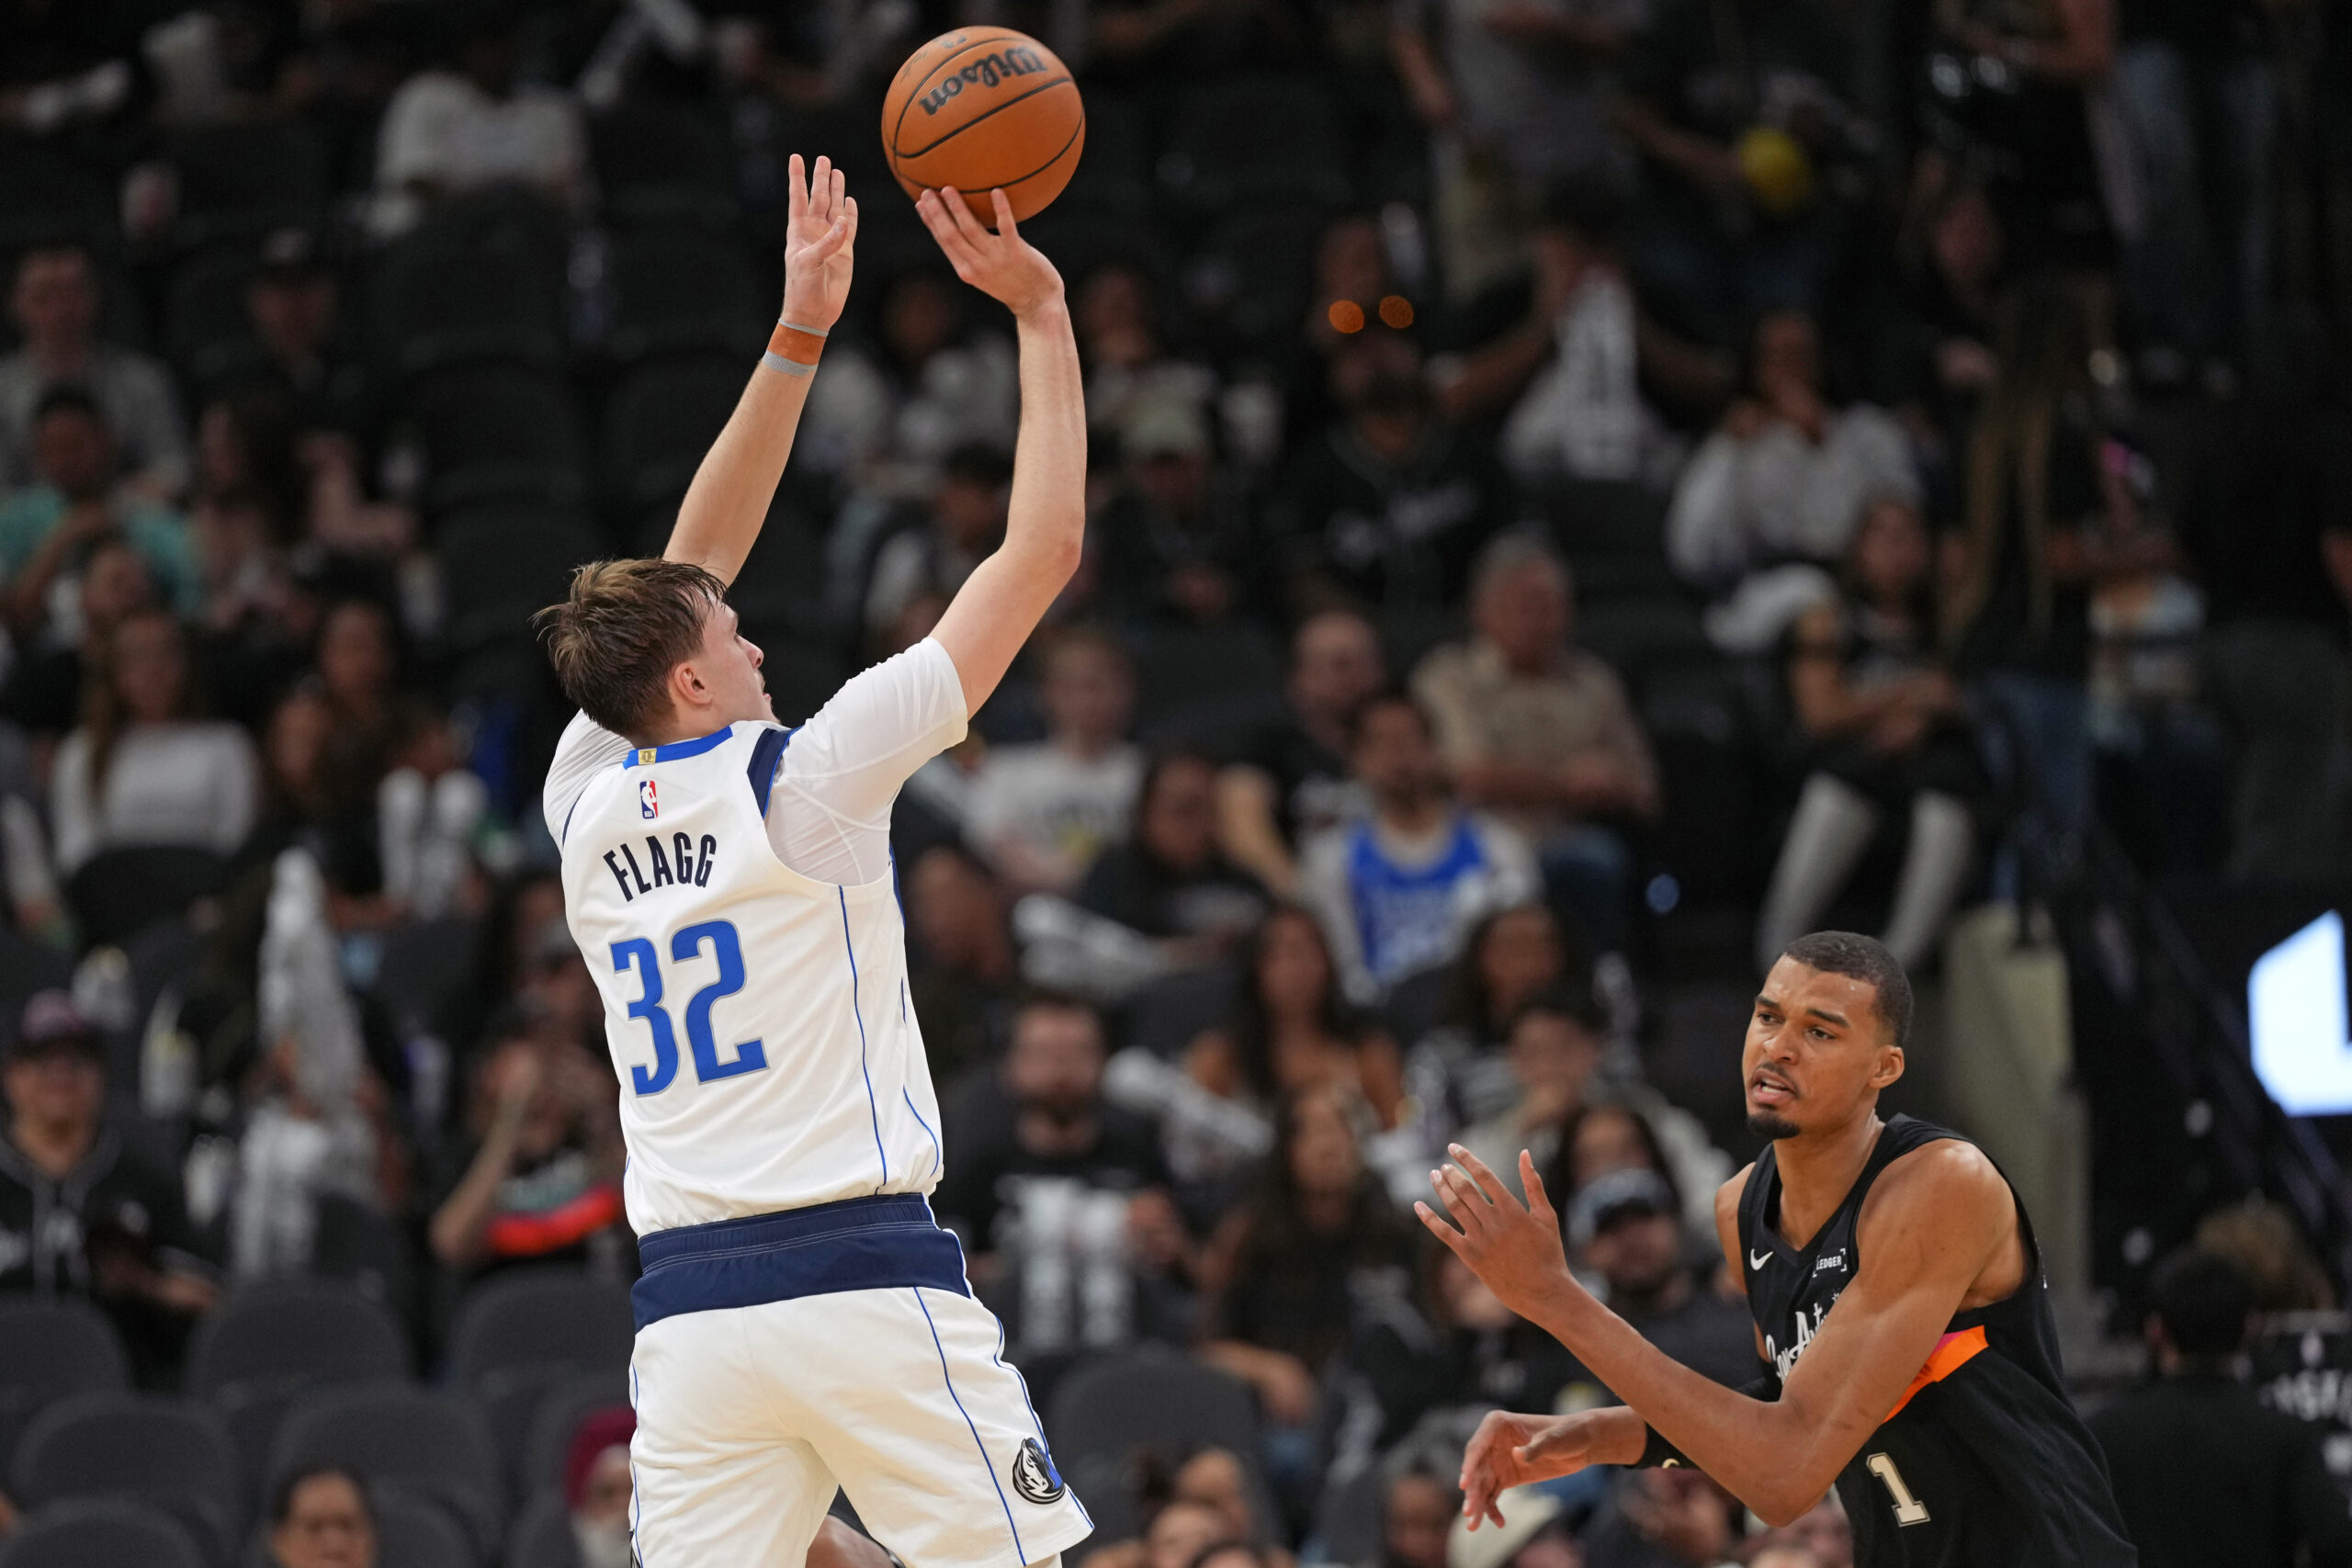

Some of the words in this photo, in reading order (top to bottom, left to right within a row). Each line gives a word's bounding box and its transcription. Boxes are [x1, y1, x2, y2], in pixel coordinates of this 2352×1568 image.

[920, 47, 1048, 116] Wilson
[603, 831, 717, 903] FLAGG
[608, 918, 771, 1099] 32
[1815, 1255, 1842, 1270] LEDGER
[1865, 1451, 1931, 1528] 1
